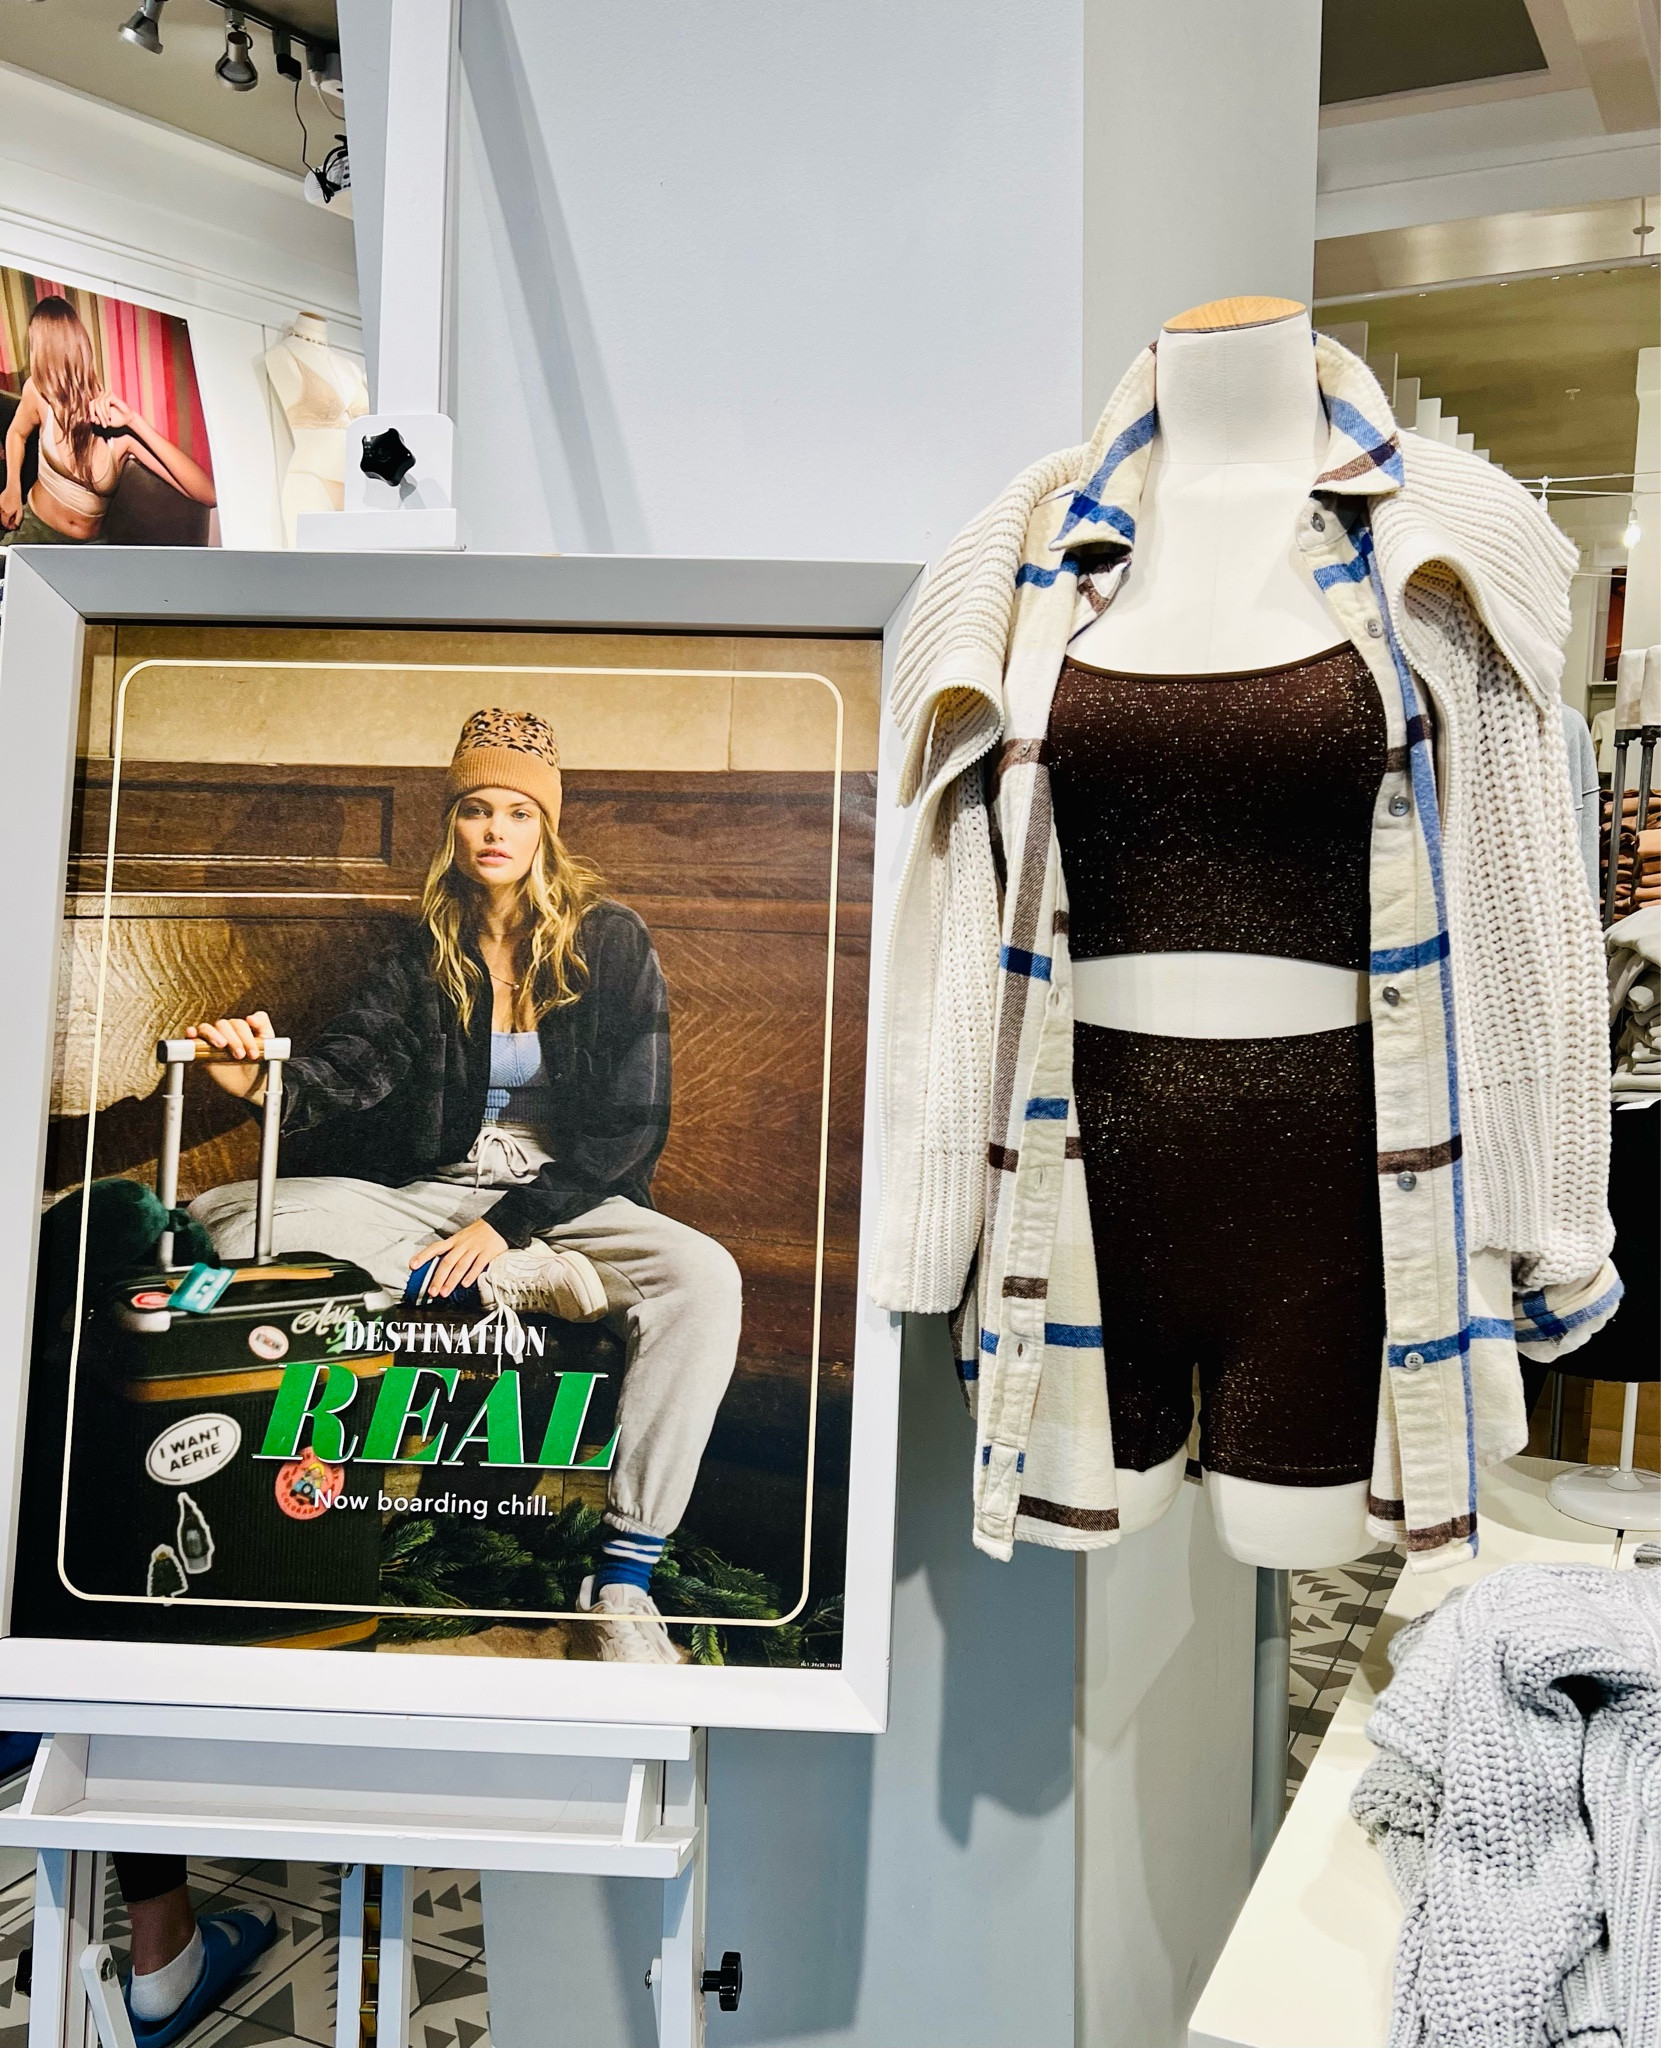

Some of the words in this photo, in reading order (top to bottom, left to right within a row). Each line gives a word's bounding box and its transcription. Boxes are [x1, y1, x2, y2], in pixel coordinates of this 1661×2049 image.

[343, 1320, 547, 1357] DESTINATION
[251, 1363, 622, 1470] REAL
[159, 1447, 165, 1459] I
[170, 1425, 221, 1454] WANT
[170, 1442, 222, 1472] AERIE
[313, 1489, 369, 1510] Now
[377, 1490, 488, 1520] boarding
[497, 1494, 554, 1516] chill.
